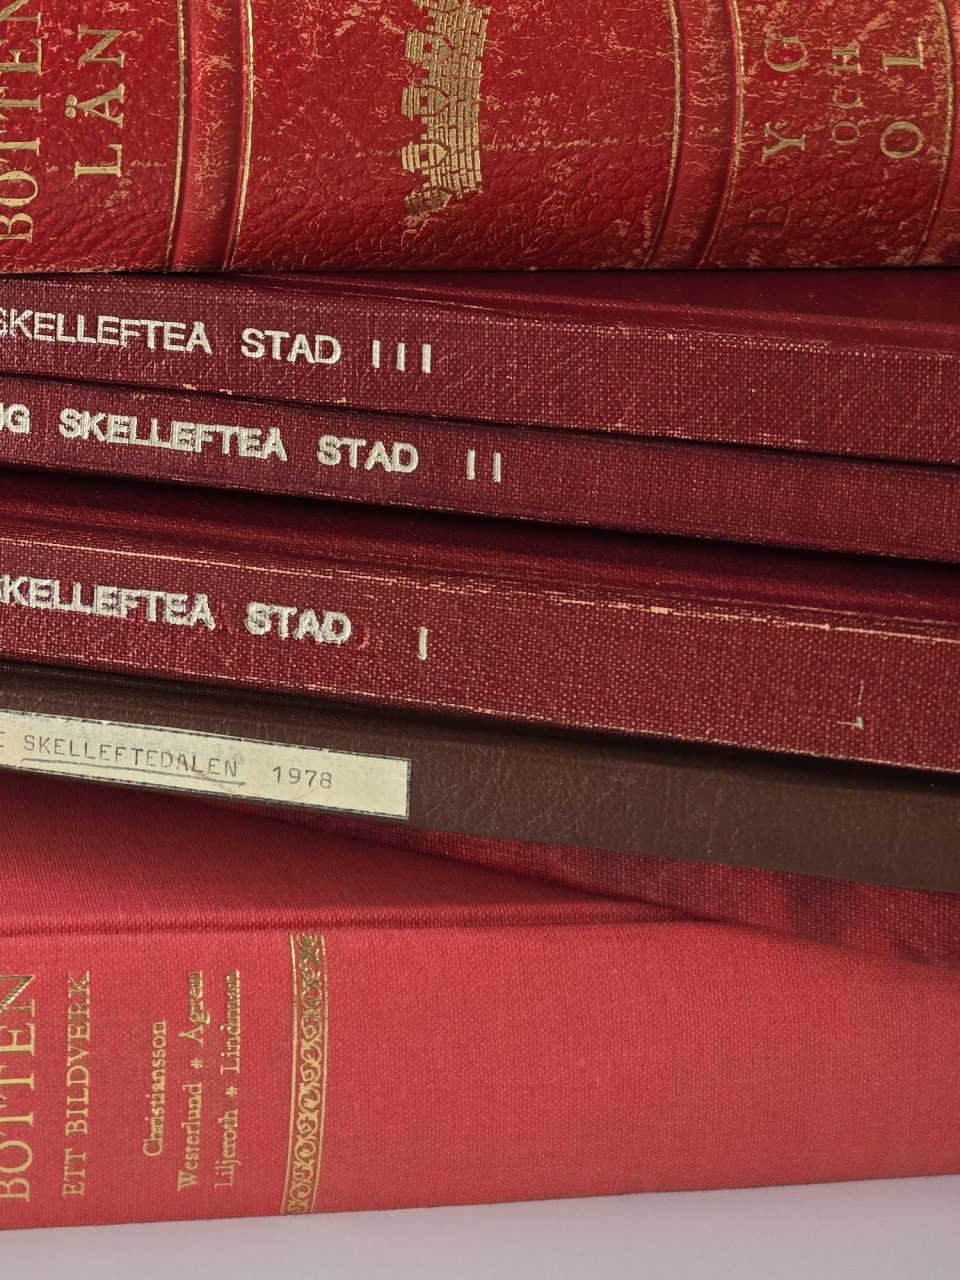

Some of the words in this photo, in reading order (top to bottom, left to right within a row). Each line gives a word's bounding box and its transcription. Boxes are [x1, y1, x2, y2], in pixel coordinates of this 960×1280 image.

[64, 25, 126, 180] LÄN
[240, 328, 342, 365] STAD
[316, 434, 420, 474] STAD
[243, 601, 353, 645] STAD
[22, 734, 240, 778] SKELLEFTEDALEN
[271, 764, 333, 790] 1978
[64, 970, 91, 1136] BILDVERK
[218, 968, 241, 1075] Lindman
[141, 1019, 167, 1158] Christiansson
[61, 1147, 87, 1198] ETT
[176, 1081, 204, 1192] Westerlund
[213, 1110, 242, 1190] Liljeroth
